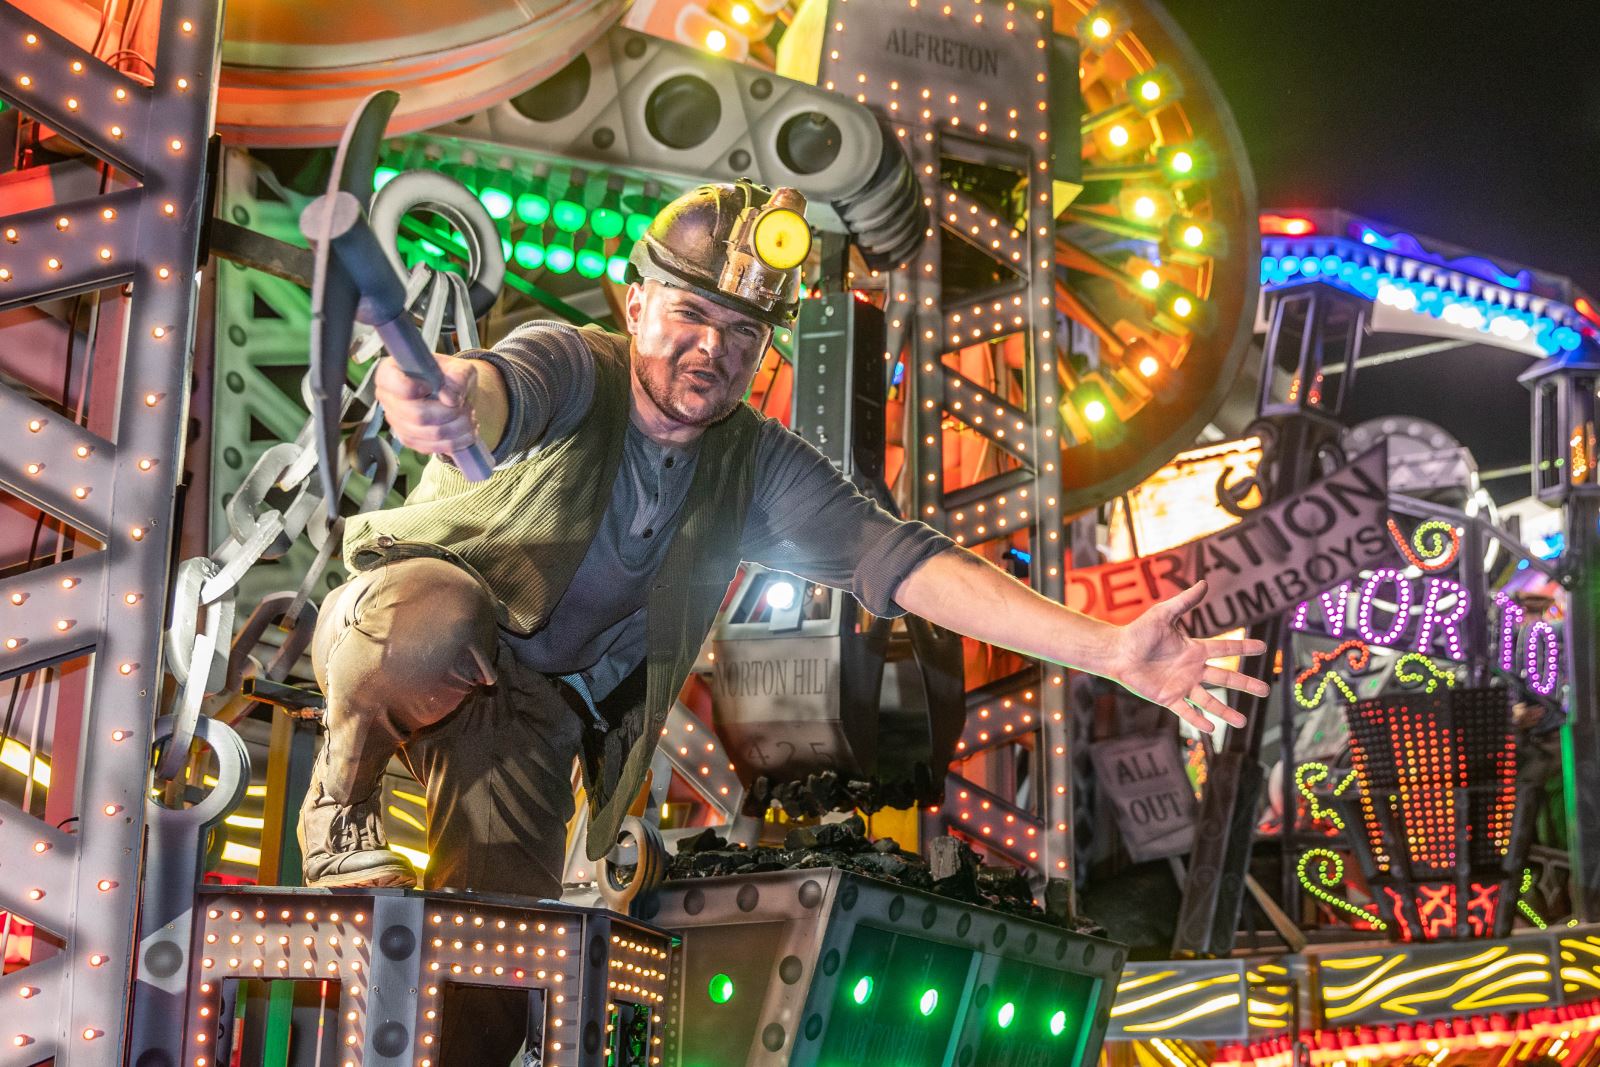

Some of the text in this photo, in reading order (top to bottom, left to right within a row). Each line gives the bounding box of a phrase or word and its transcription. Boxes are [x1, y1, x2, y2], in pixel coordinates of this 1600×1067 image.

[885, 27, 999, 77] ALFRETON
[1174, 525, 1389, 637] MUMBOYS
[714, 657, 832, 698] NORTON HILL
[1116, 751, 1169, 786] ALL
[1130, 790, 1182, 825] OUT
